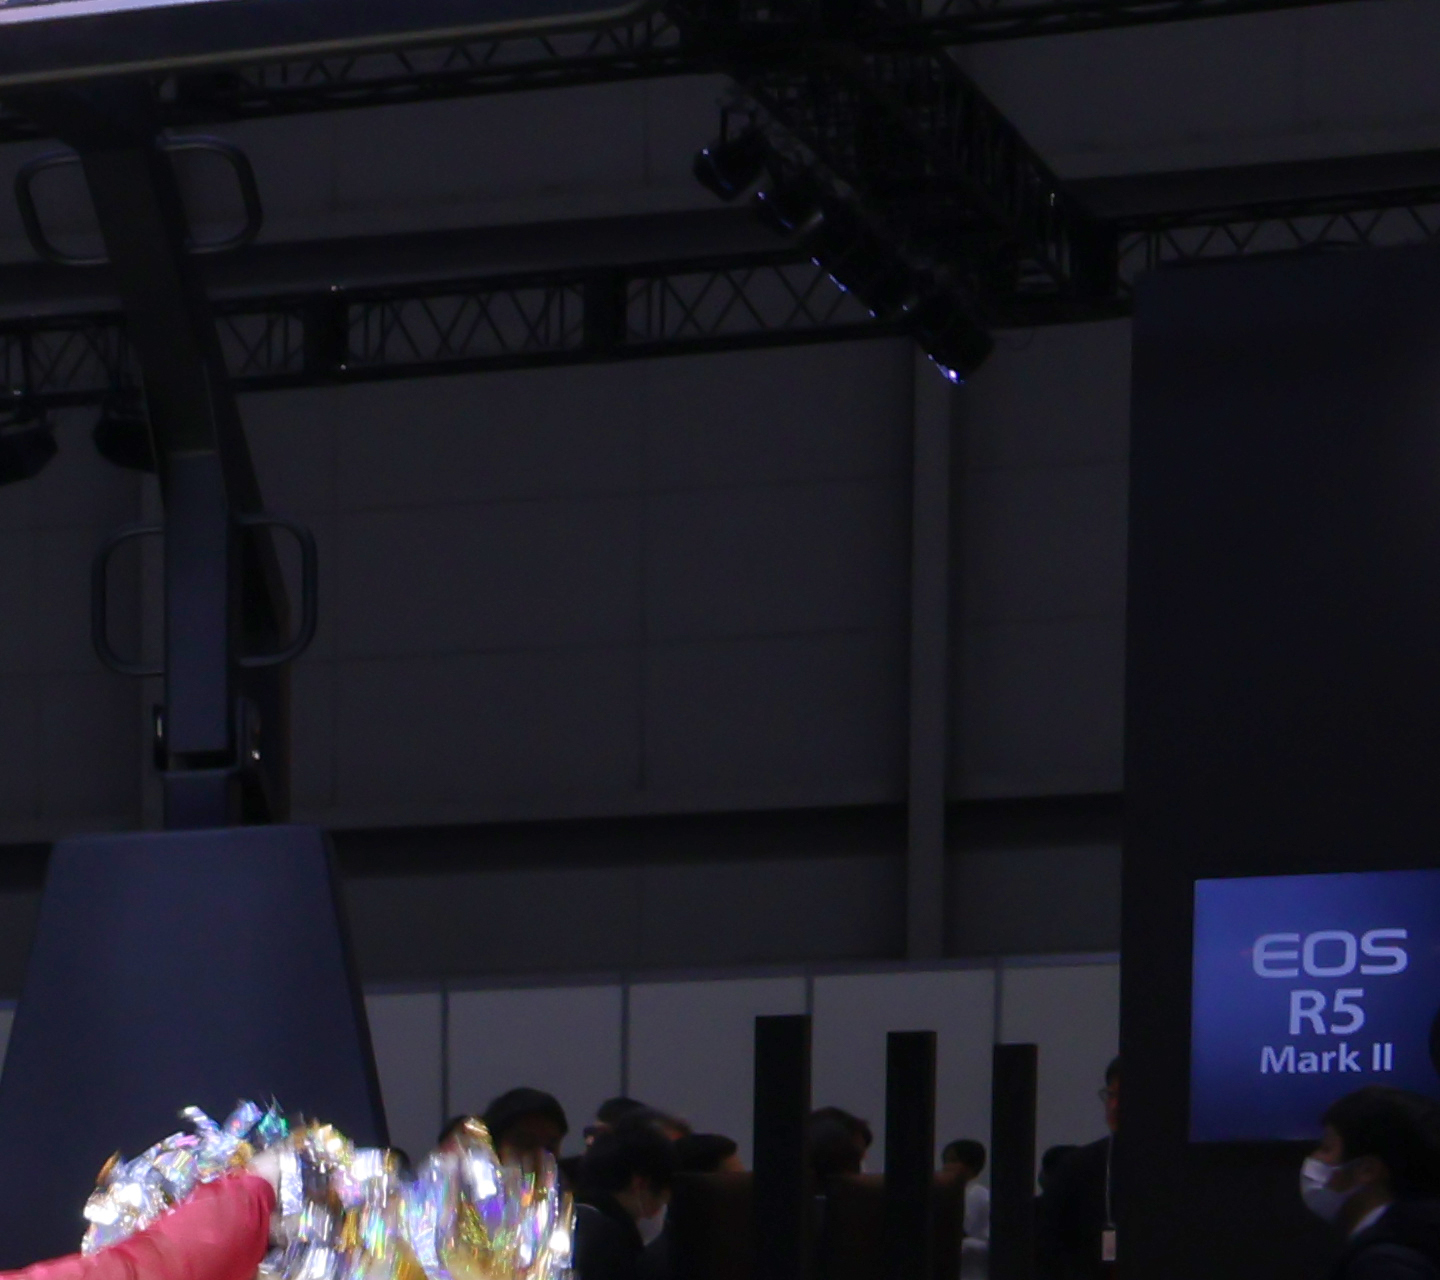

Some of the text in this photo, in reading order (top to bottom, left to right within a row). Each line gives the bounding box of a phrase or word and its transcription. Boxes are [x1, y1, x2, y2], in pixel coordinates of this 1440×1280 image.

[1252, 928, 1409, 979] EOS
[1288, 987, 1366, 1036] R5
[1260, 1041, 1394, 1075] Mark II
